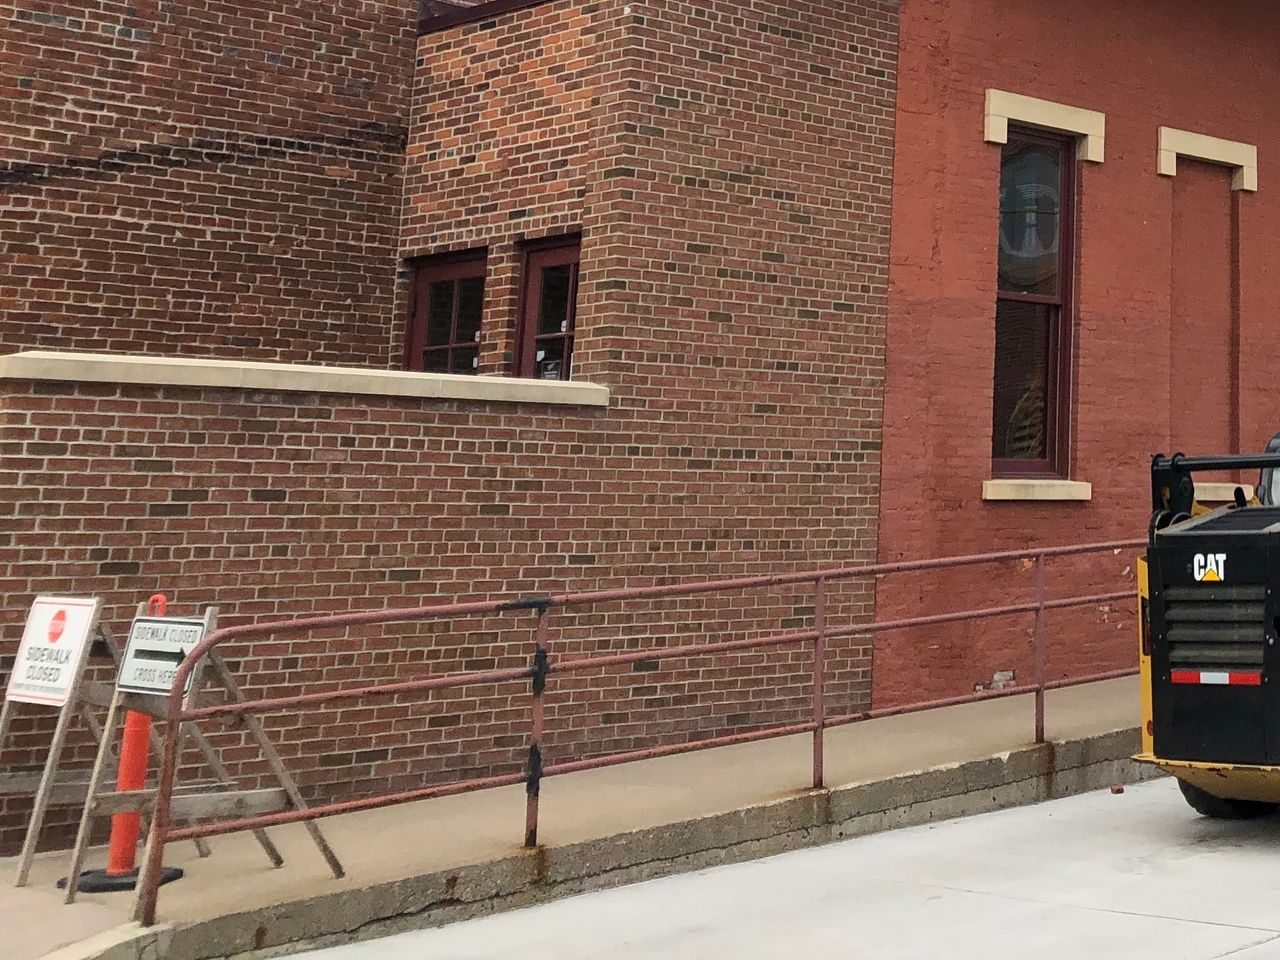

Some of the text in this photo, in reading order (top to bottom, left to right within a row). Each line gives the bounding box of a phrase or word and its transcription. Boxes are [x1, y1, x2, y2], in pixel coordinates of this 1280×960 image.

[1193, 553, 1227, 582] CAT
[135, 626, 198, 644] SIDEWALK CLOSED
[26, 646, 72, 664] SIDEWALK
[26, 665, 60, 682] CLOSED
[133, 667, 157, 682] CROSS
